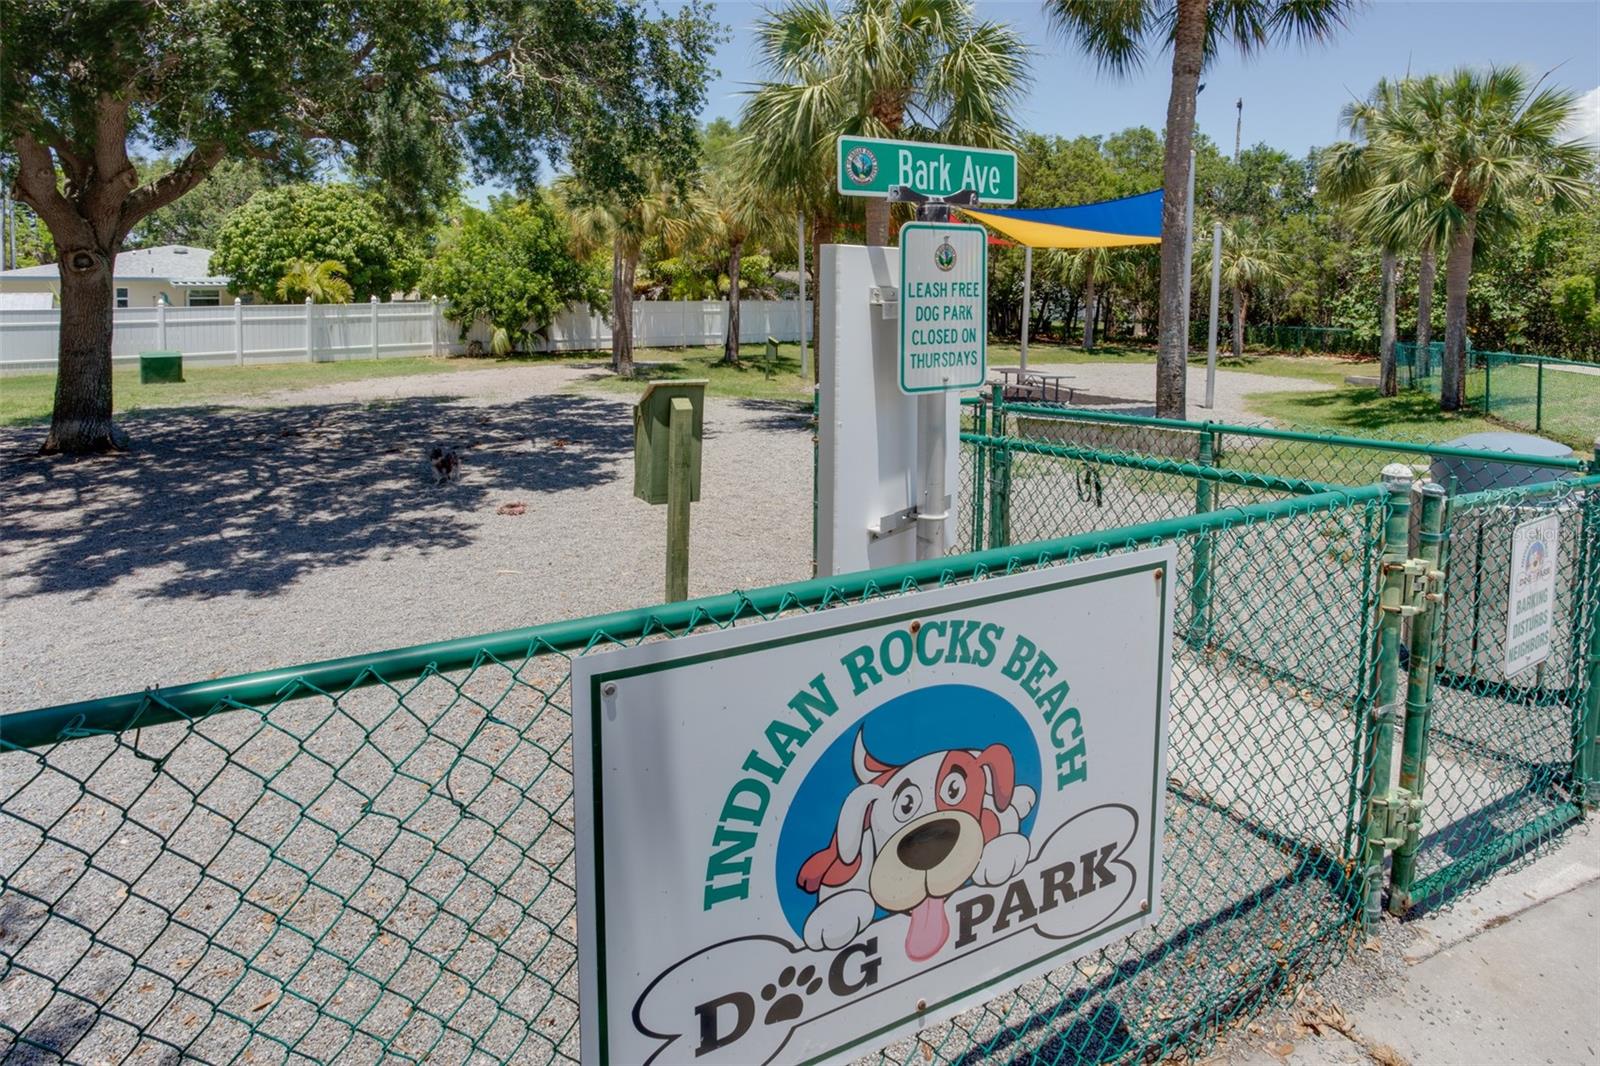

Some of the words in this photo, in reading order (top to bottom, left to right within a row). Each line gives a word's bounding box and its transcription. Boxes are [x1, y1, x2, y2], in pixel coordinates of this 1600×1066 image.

[898, 149, 952, 192] Bark
[962, 155, 1001, 195] Ave
[908, 282, 947, 298] LEASH
[951, 282, 980, 297] FREE
[915, 306, 939, 322] DOG
[943, 305, 973, 321] PARK
[911, 328, 958, 345] CLOSED
[961, 327, 976, 343] ON
[910, 350, 978, 369] THURSDAYS
[1516, 589, 1548, 616] BARKING
[1513, 610, 1548, 640] DISTURBS
[1509, 631, 1548, 663] NEIGHBORS
[703, 672, 840, 912] INDIAN
[840, 620, 1005, 697] ROCKS
[1001, 634, 1088, 791] BEACH
[955, 842, 1119, 950] PARK
